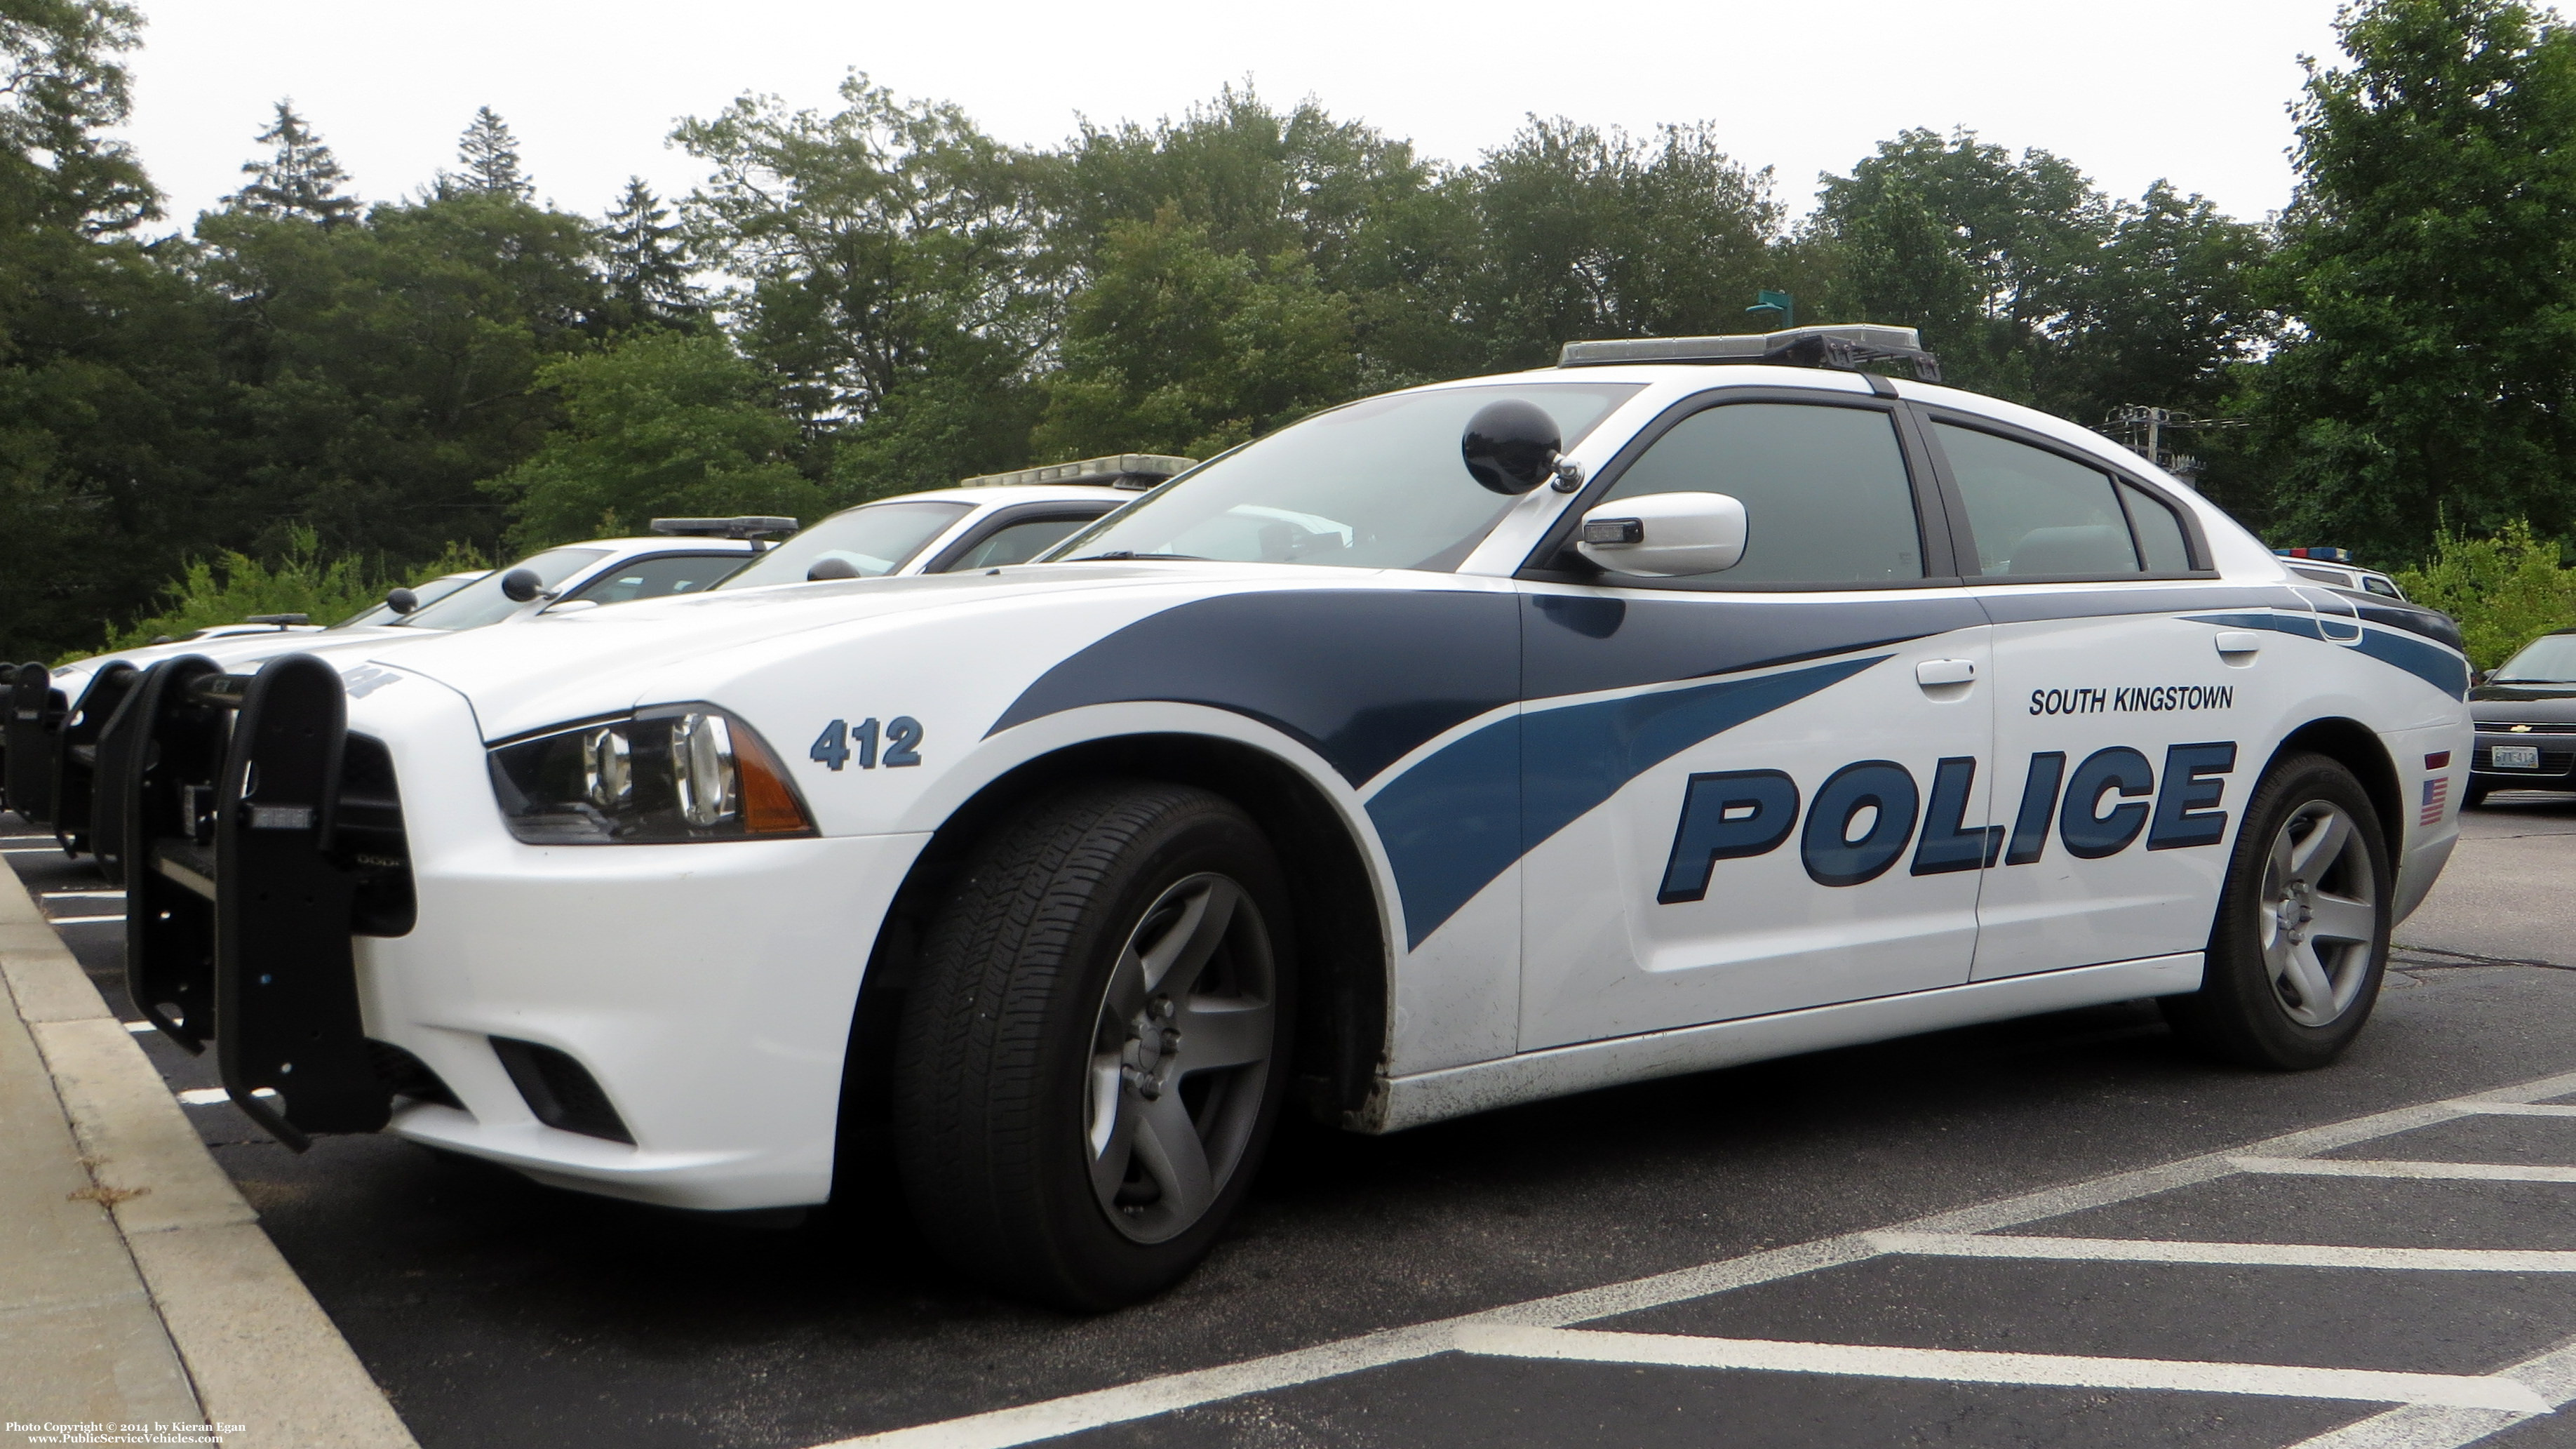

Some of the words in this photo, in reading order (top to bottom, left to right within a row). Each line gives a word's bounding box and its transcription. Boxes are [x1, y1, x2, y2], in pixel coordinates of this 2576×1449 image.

[2030, 688, 2107, 716] SOUTH
[2113, 686, 2234, 712] KINGSTOWN
[810, 716, 923, 772] 412
[1656, 741, 2238, 905] POLICE
